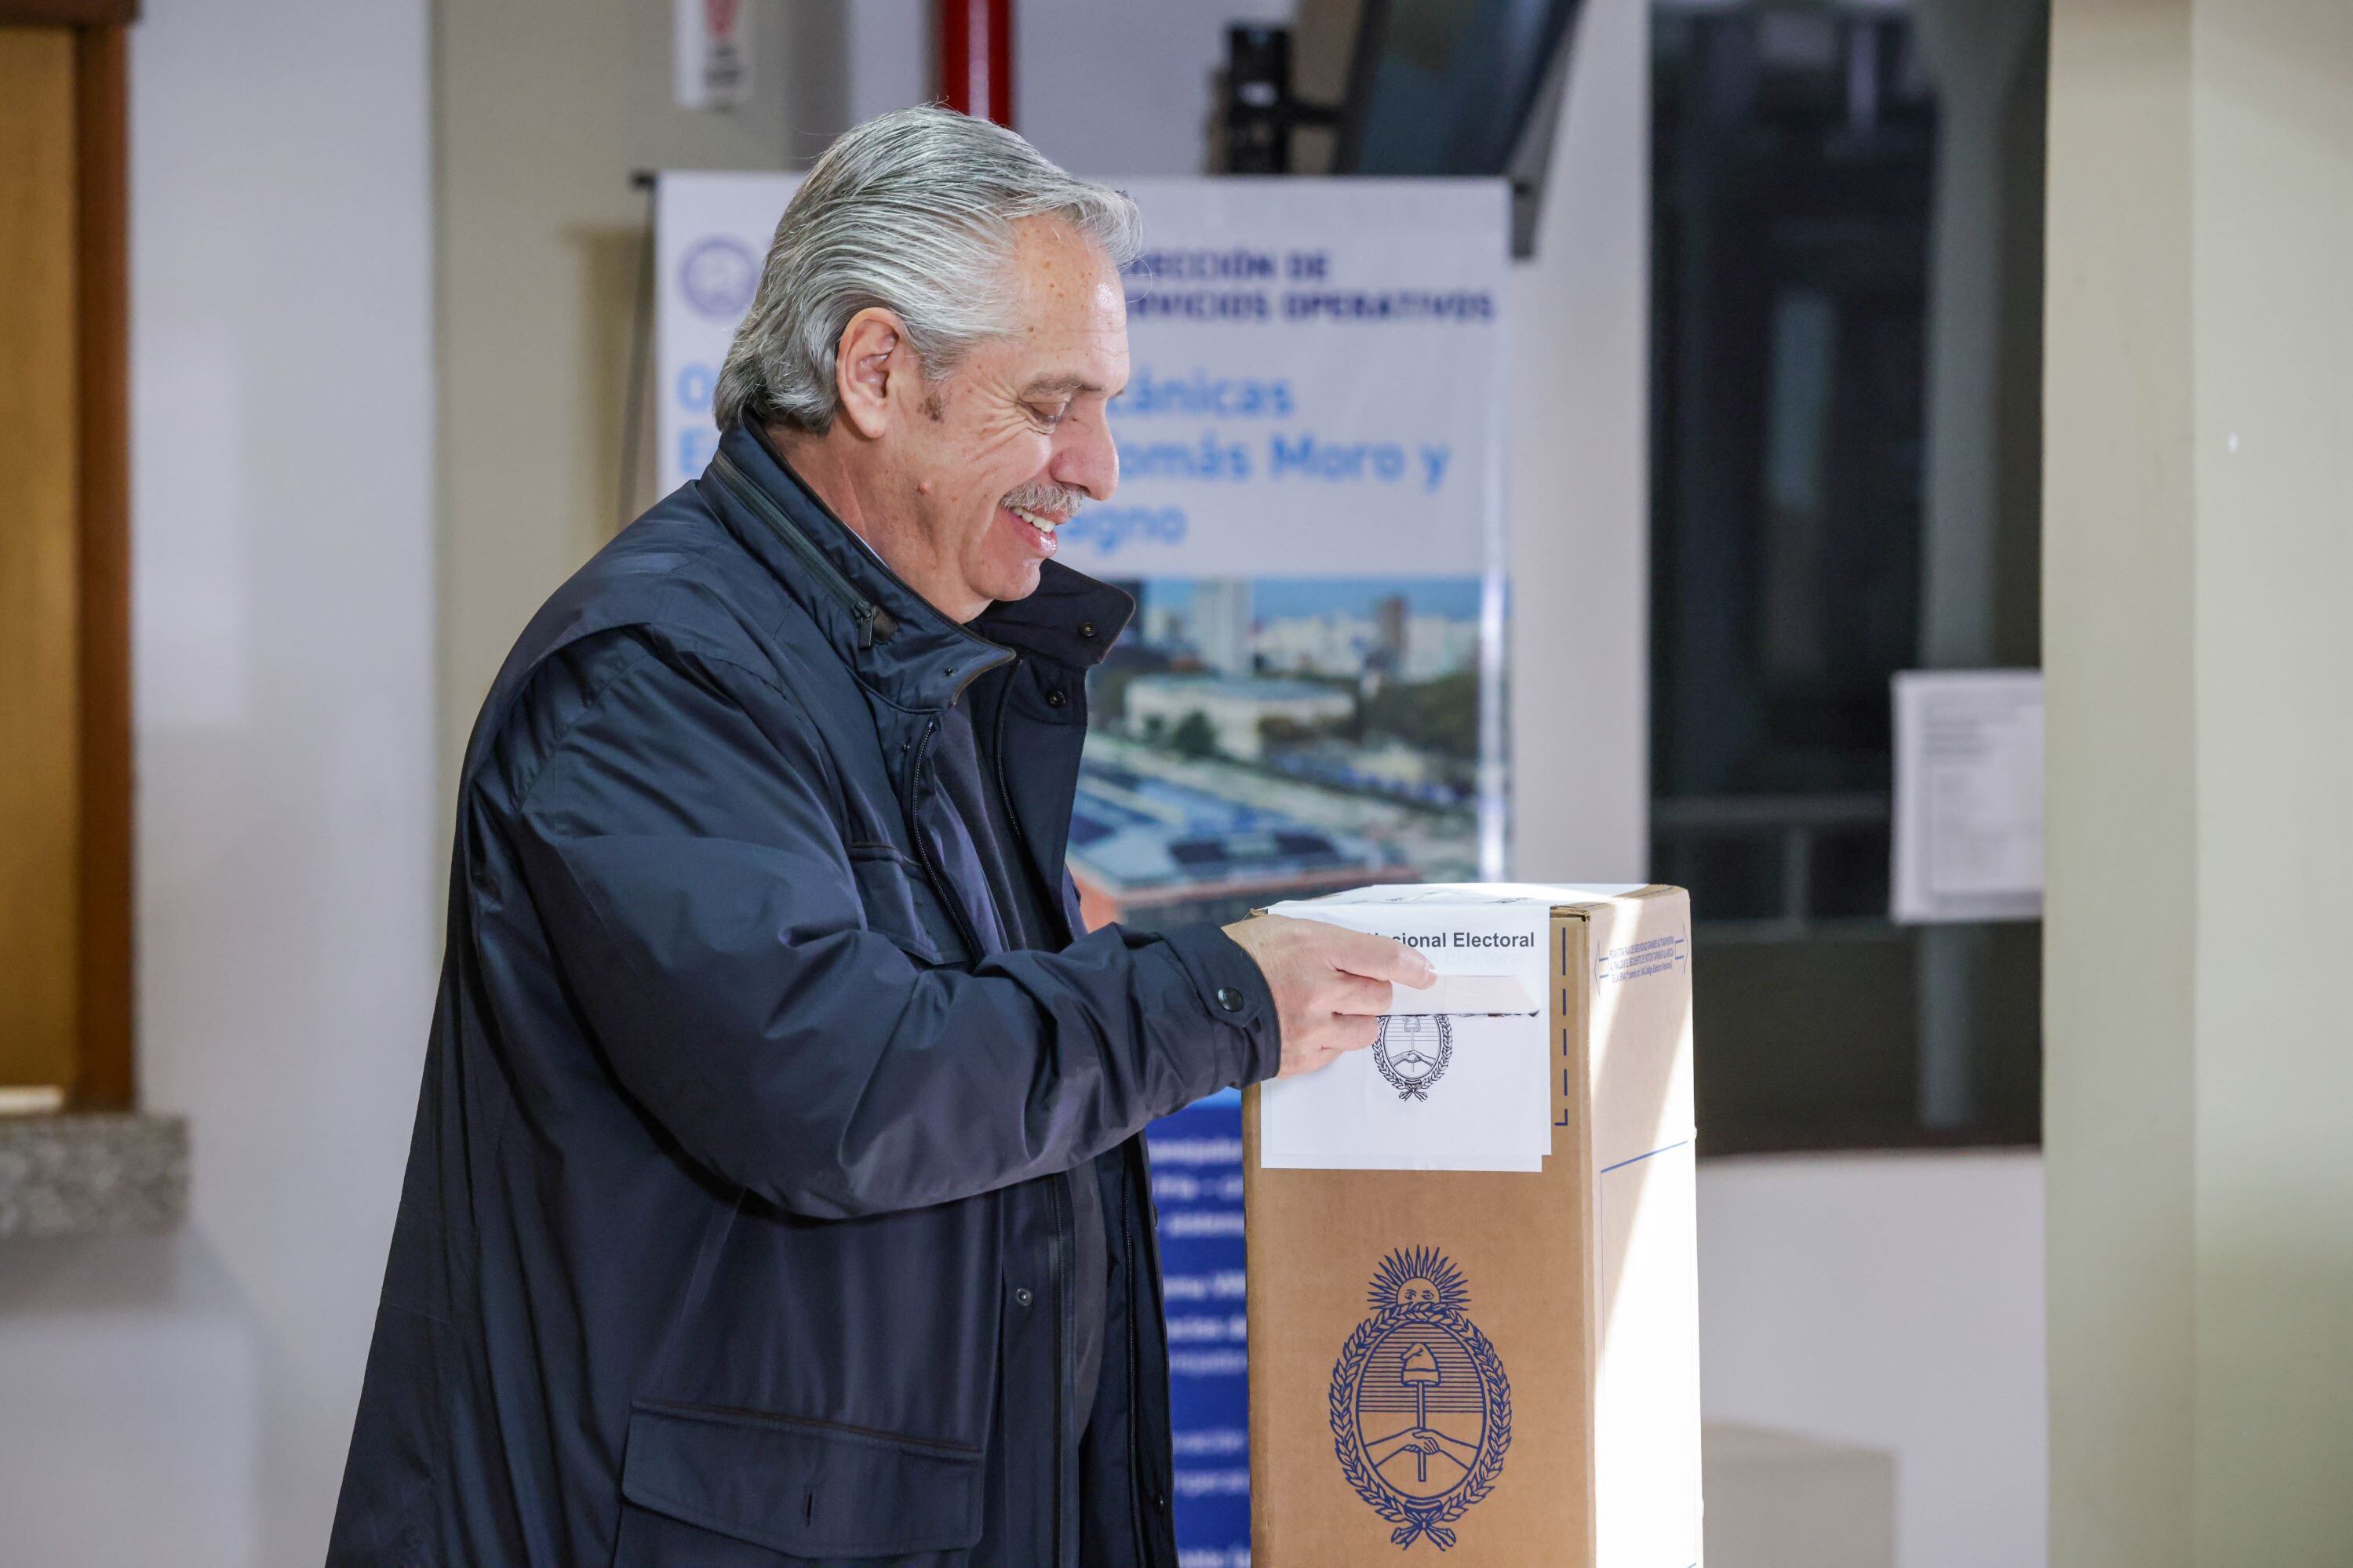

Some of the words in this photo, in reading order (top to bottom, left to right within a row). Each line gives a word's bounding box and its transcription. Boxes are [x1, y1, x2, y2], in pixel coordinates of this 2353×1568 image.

[1122, 249, 1273, 278] RECCIÓN
[1284, 252, 1328, 278] DE
[1284, 290, 1495, 317] OPERATIVOS
[1117, 431, 1250, 480] omás
[1270, 435, 1406, 481] Moro
[1419, 442, 1452, 493] y
[1065, 506, 1186, 552] agno
[1368, 932, 1446, 947] ional
[1454, 932, 1534, 947] Electoral
